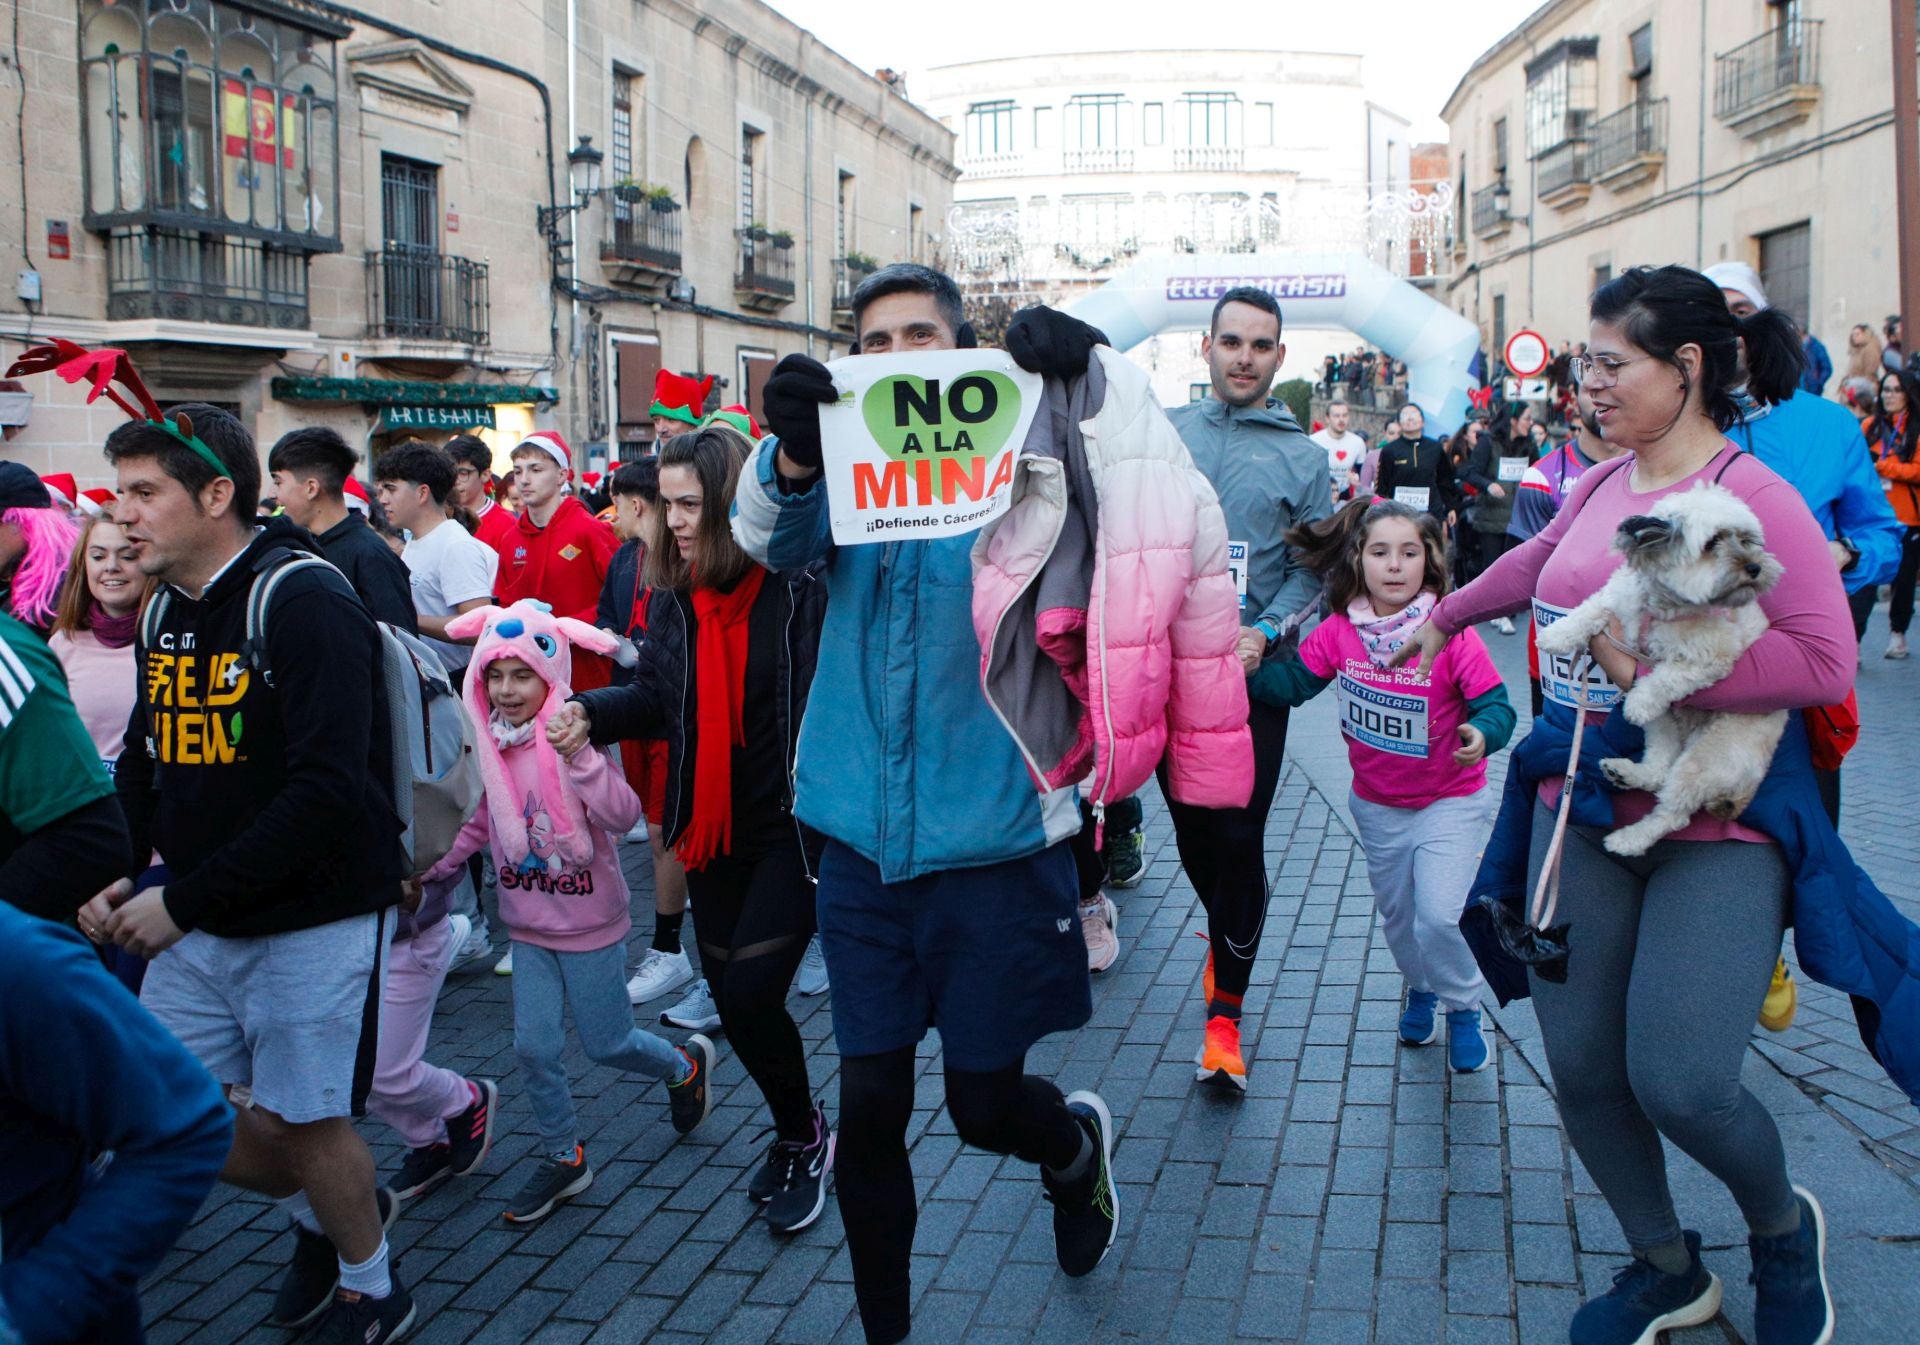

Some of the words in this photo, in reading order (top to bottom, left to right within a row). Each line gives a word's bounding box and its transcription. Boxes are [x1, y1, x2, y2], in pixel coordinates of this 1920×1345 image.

[390, 406, 492, 424] ARTESANIA
[893, 376, 998, 427] NO
[901, 432, 924, 454] A
[934, 430, 975, 452] LA
[853, 449, 1013, 509] MINA
[866, 516, 939, 533] ¡¡Defiende
[943, 502, 996, 525] Cáceres!!
[1345, 658, 1375, 670] Circuito
[1345, 666, 1392, 683] Marchas
[1394, 673, 1432, 687] Rosas
[1341, 679, 1424, 711] ELECTROCASH
[1349, 700, 1412, 739] 0061
